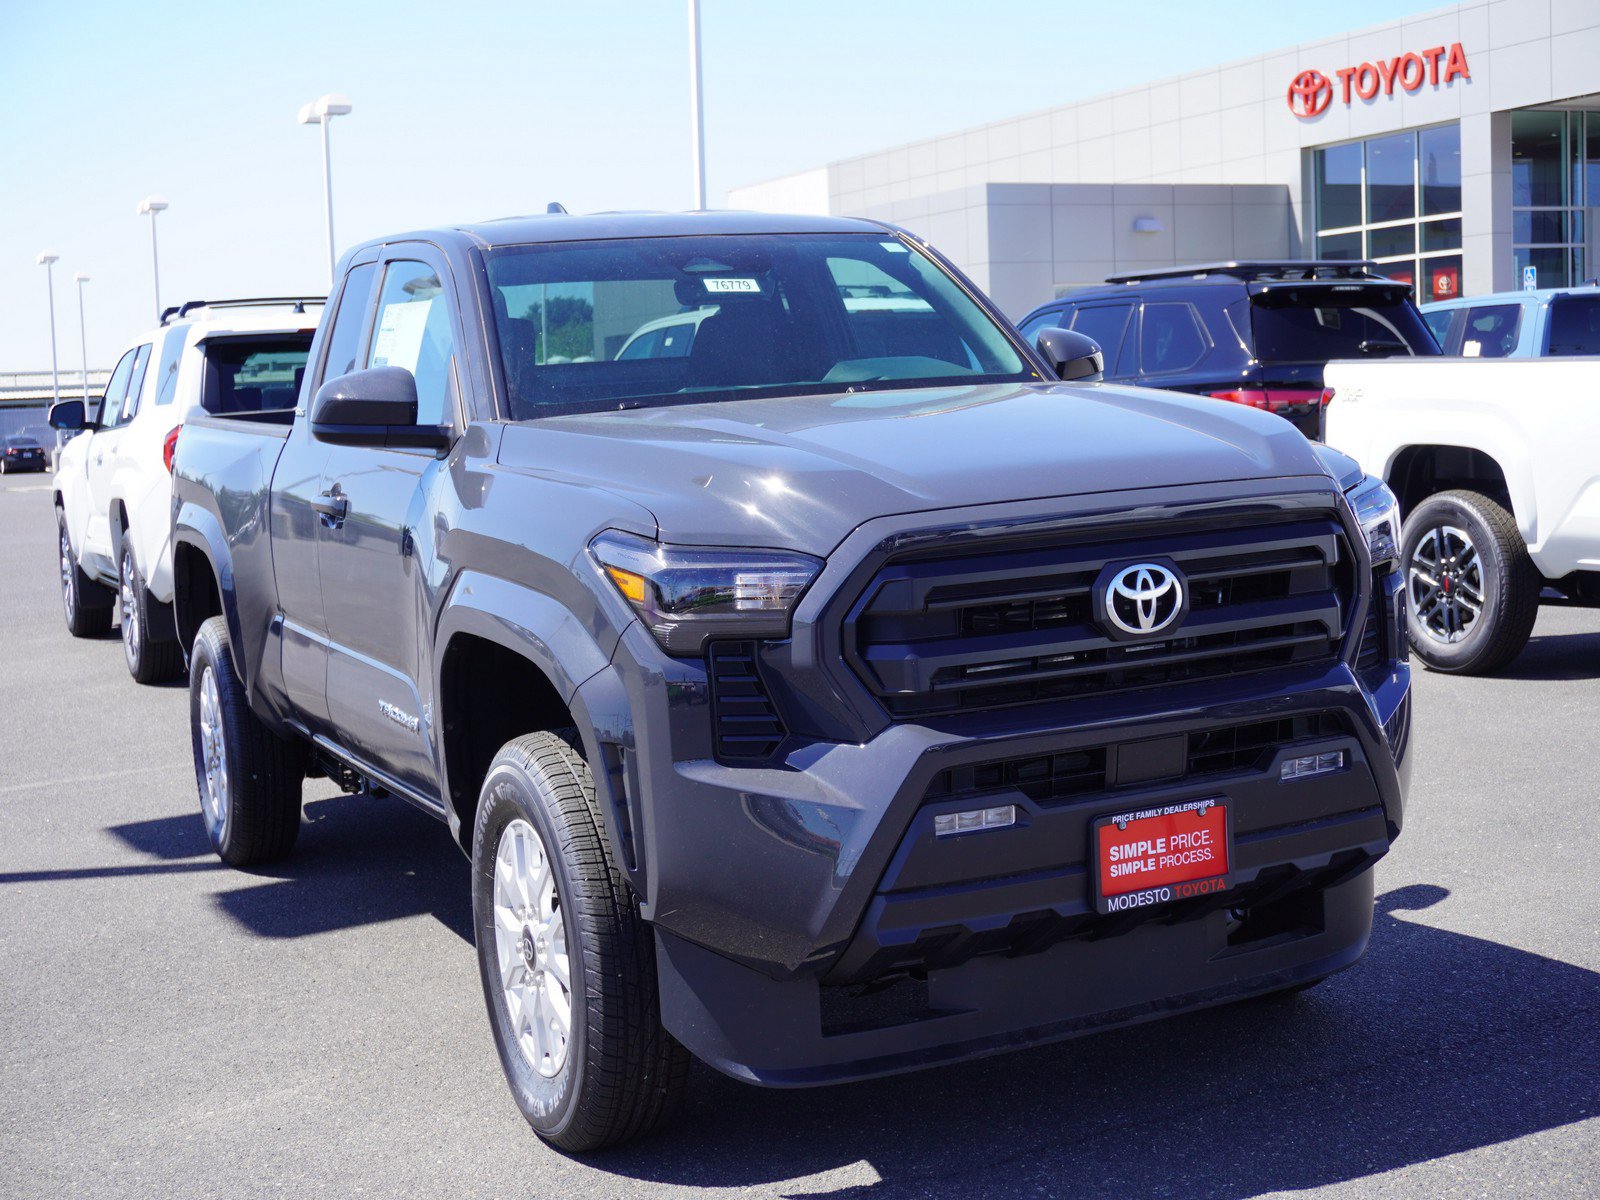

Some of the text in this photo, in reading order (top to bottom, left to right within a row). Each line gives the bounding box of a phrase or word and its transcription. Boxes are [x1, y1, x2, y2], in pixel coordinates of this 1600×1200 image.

[1335, 42, 1470, 104] TOYOTA
[712, 280, 751, 290] 76779
[1112, 799, 1215, 824] PRICE FAMILY DEALERSHIPS
[1109, 829, 1213, 862] SIMPLE PRICE.
[1110, 848, 1215, 877] SIMPLE PROCESS.
[1107, 878, 1226, 912] MODESTO TOYOTA
